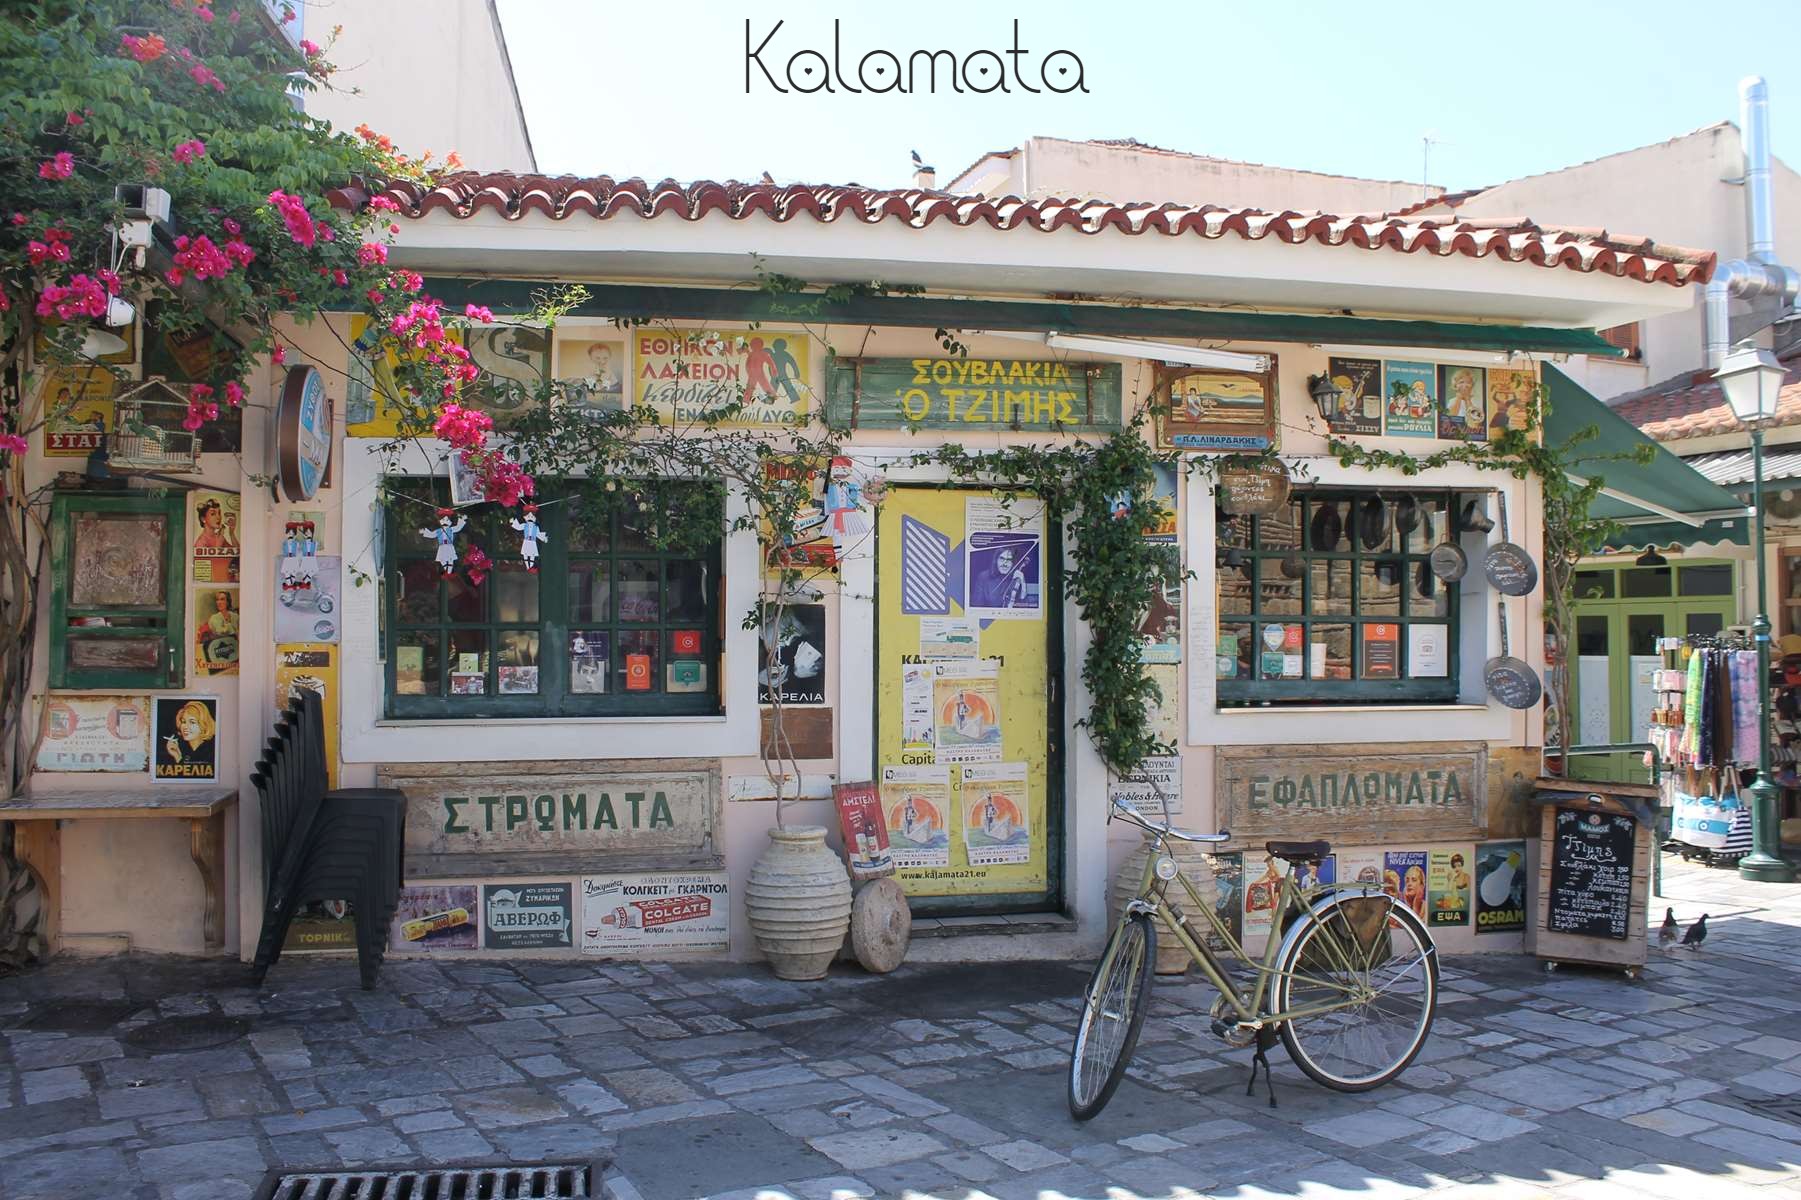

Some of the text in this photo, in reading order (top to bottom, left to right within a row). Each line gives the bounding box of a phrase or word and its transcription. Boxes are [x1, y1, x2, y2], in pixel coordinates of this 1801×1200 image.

[911, 359, 1072, 386] ΣΟΥΒΛΑΚΙΑ
[940, 388, 1079, 425] ΤΖΙΜΗΣ
[156, 764, 214, 777] ΚΑΡΕΛΙΑ
[444, 791, 674, 834] ΣΤΡΩΜΑΤΑ
[901, 870, 987, 880] www.kalamata21.eu
[494, 911, 562, 927] ΑΒΕΡΩΦ
[645, 902, 710, 920] COLGATE
[1437, 912, 1462, 921] ΕΨΑ
[1477, 910, 1525, 925] OSRAM
